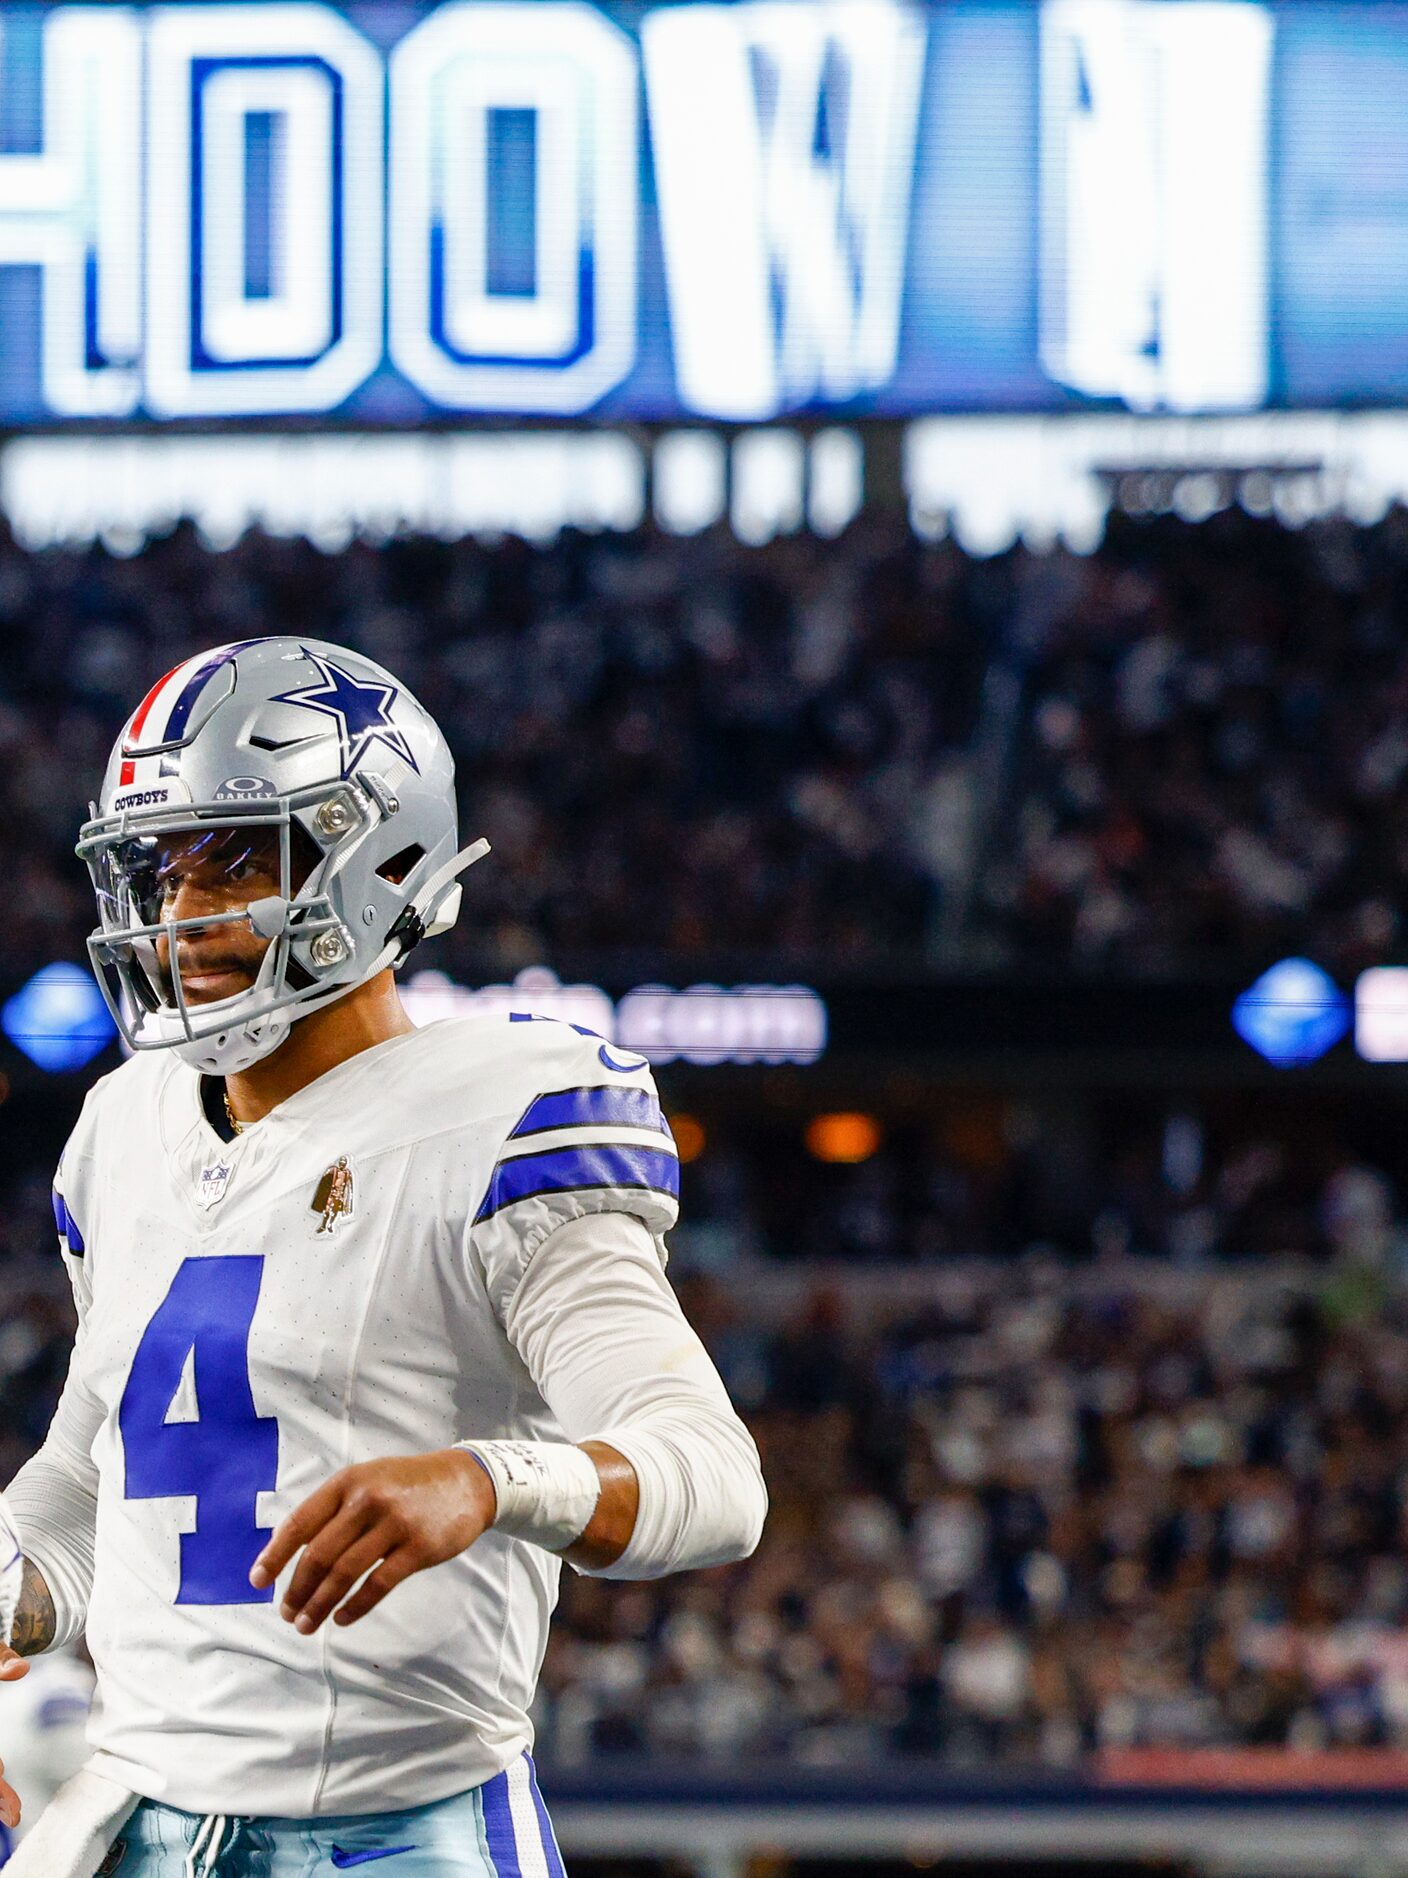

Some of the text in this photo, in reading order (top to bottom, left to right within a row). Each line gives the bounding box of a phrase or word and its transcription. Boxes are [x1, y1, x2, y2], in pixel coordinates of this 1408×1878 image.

[114, 789, 169, 812] COWBOYS
[215, 792, 275, 800] OAKLEY
[118, 1254, 279, 1606] 4
